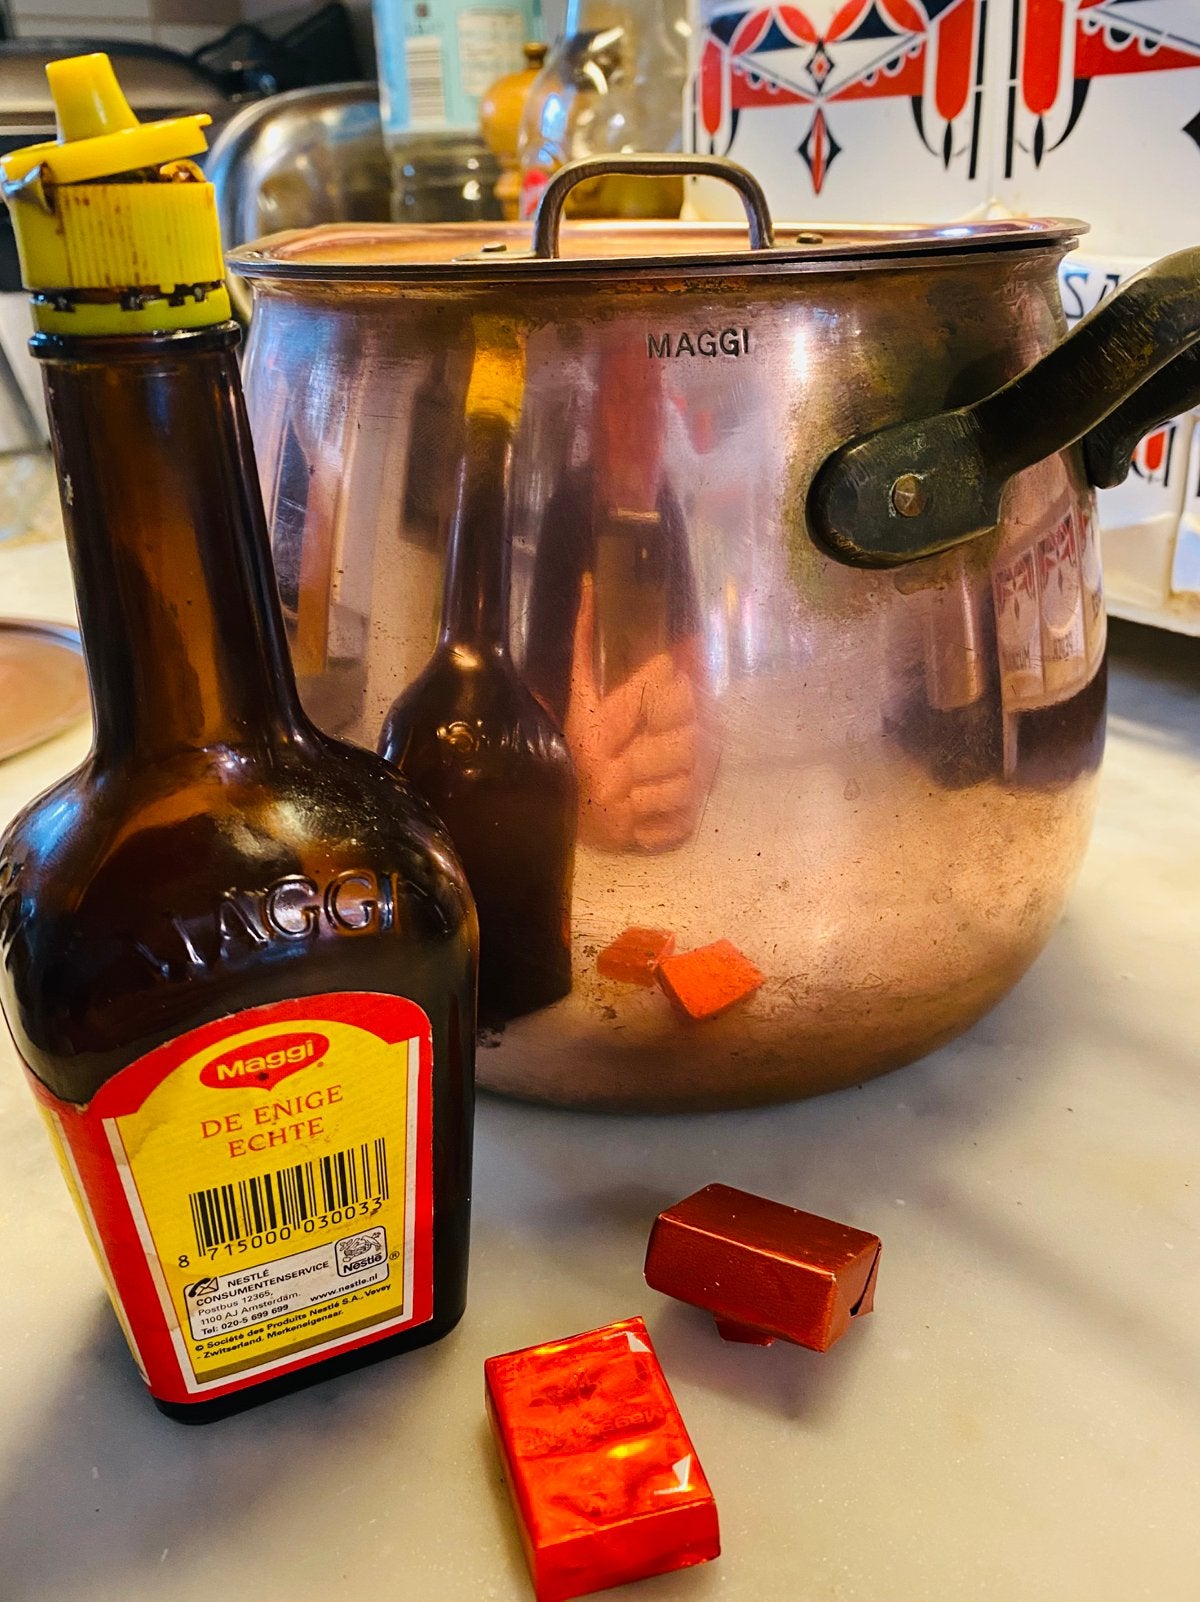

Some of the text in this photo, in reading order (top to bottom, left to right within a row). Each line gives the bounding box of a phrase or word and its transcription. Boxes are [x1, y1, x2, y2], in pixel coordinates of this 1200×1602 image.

[647, 328, 749, 358] MAGGI
[216, 1040, 315, 1081] Maggi
[201, 1085, 344, 1139] DE ENIGE
[228, 1117, 325, 1158] ECHTE
[178, 1197, 382, 1268] 8 715000 030033
[227, 1268, 270, 1288] NESTLÉ
[343, 1252, 382, 1274] Nestlé
[196, 1260, 330, 1307] CONSUMENTENSERVICE
[310, 1273, 378, 1302] www.nestle.nl
[198, 1301, 239, 1316] Postbus
[201, 1292, 301, 1326] 1100 AJ Amsterdam.
[201, 1304, 289, 1335] Tel: 020-5 699 699
[207, 1333, 245, 1349] Société
[247, 1327, 264, 1337] des
[267, 1313, 307, 1331] Produits
[309, 1300, 340, 1317] Nestlé
[364, 1284, 391, 1297] Vevey
[203, 1336, 265, 1359] Zwitserland.
